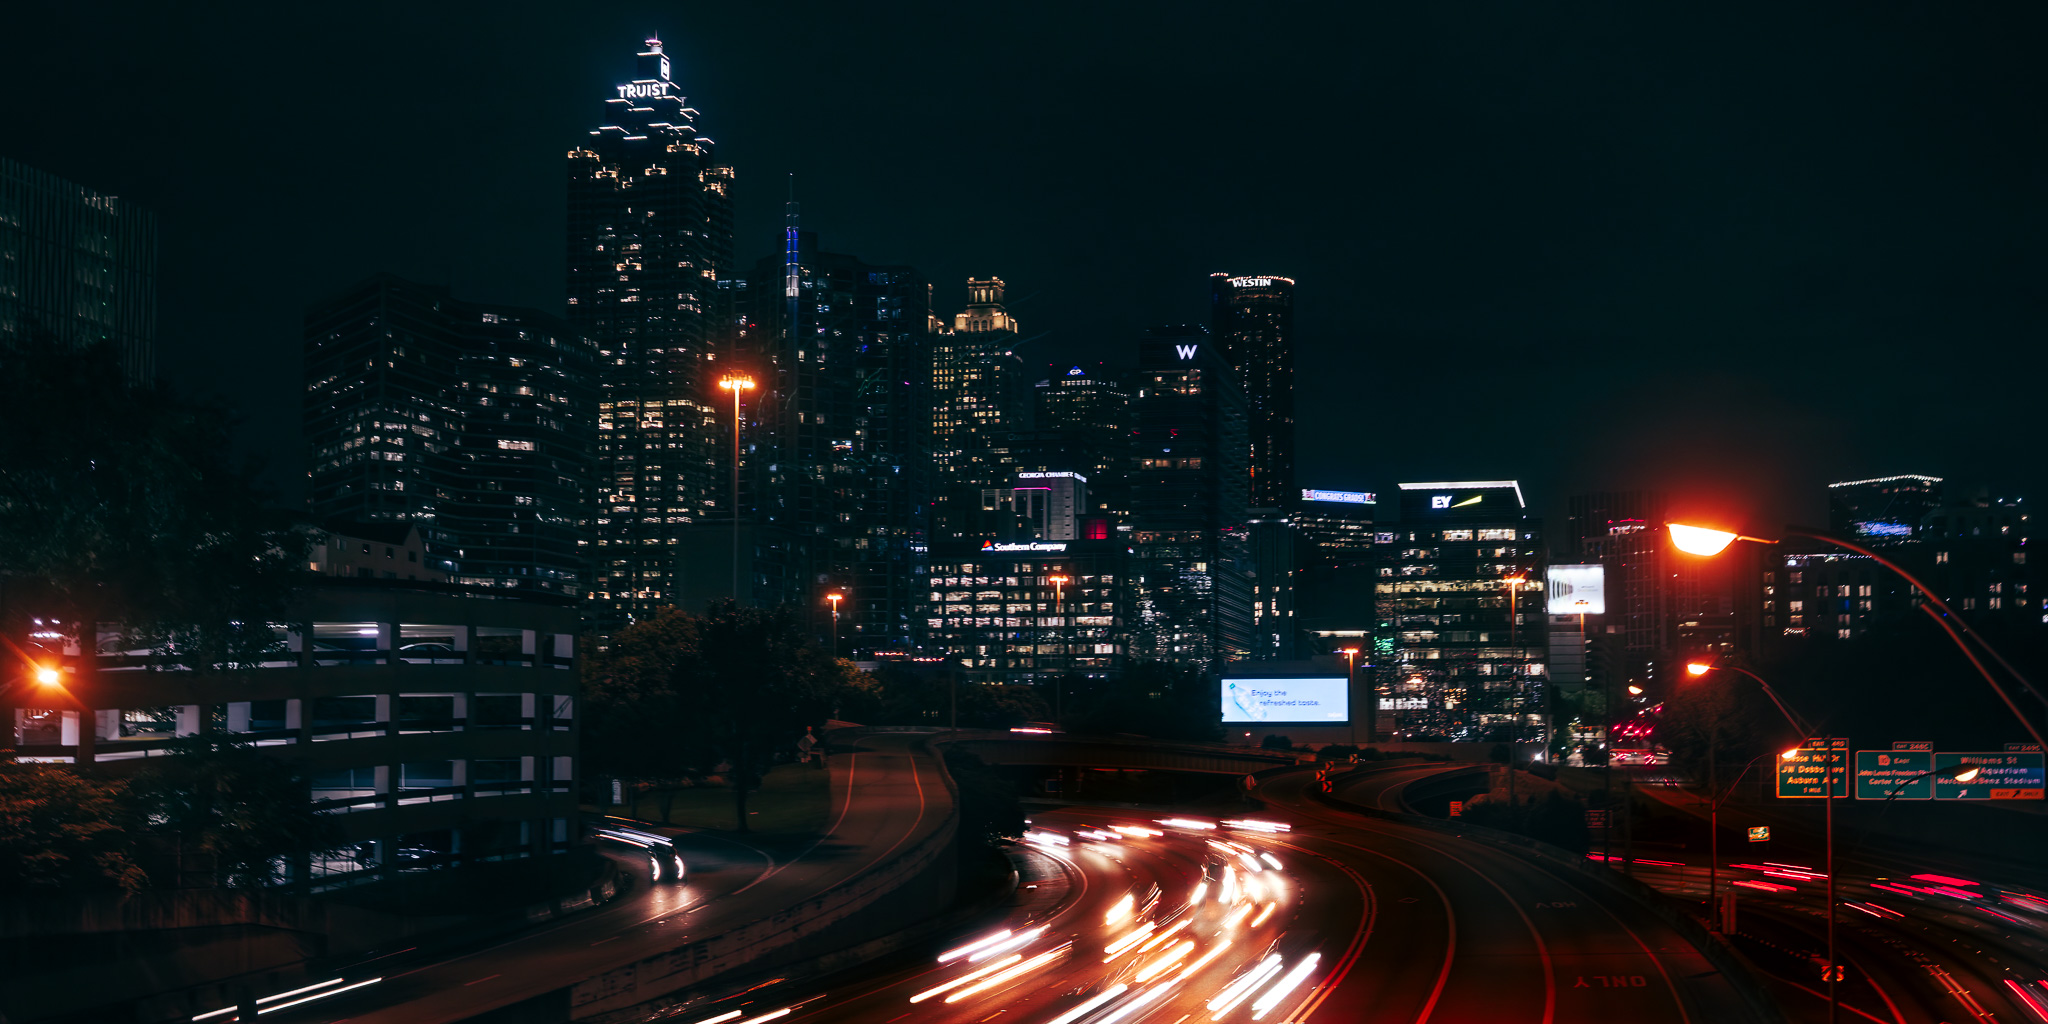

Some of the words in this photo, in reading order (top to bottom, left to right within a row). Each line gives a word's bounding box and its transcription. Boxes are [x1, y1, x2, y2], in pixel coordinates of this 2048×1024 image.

[616, 83, 669, 98] TRUIST
[1232, 278, 1271, 287] WESTIN
[1175, 344, 1198, 360] W
[1431, 495, 1453, 508] EY
[993, 542, 1030, 551] Southern
[1030, 541, 1067, 552] Company
[1251, 689, 1272, 697] Enjoy
[1979, 766, 2028, 776] Aquarium
[1787, 776, 1819, 784] Auburn
[1822, 776, 1839, 784] Ae
[2004, 776, 2041, 784] Stadium
[1573, 976, 1648, 988] ONLY
